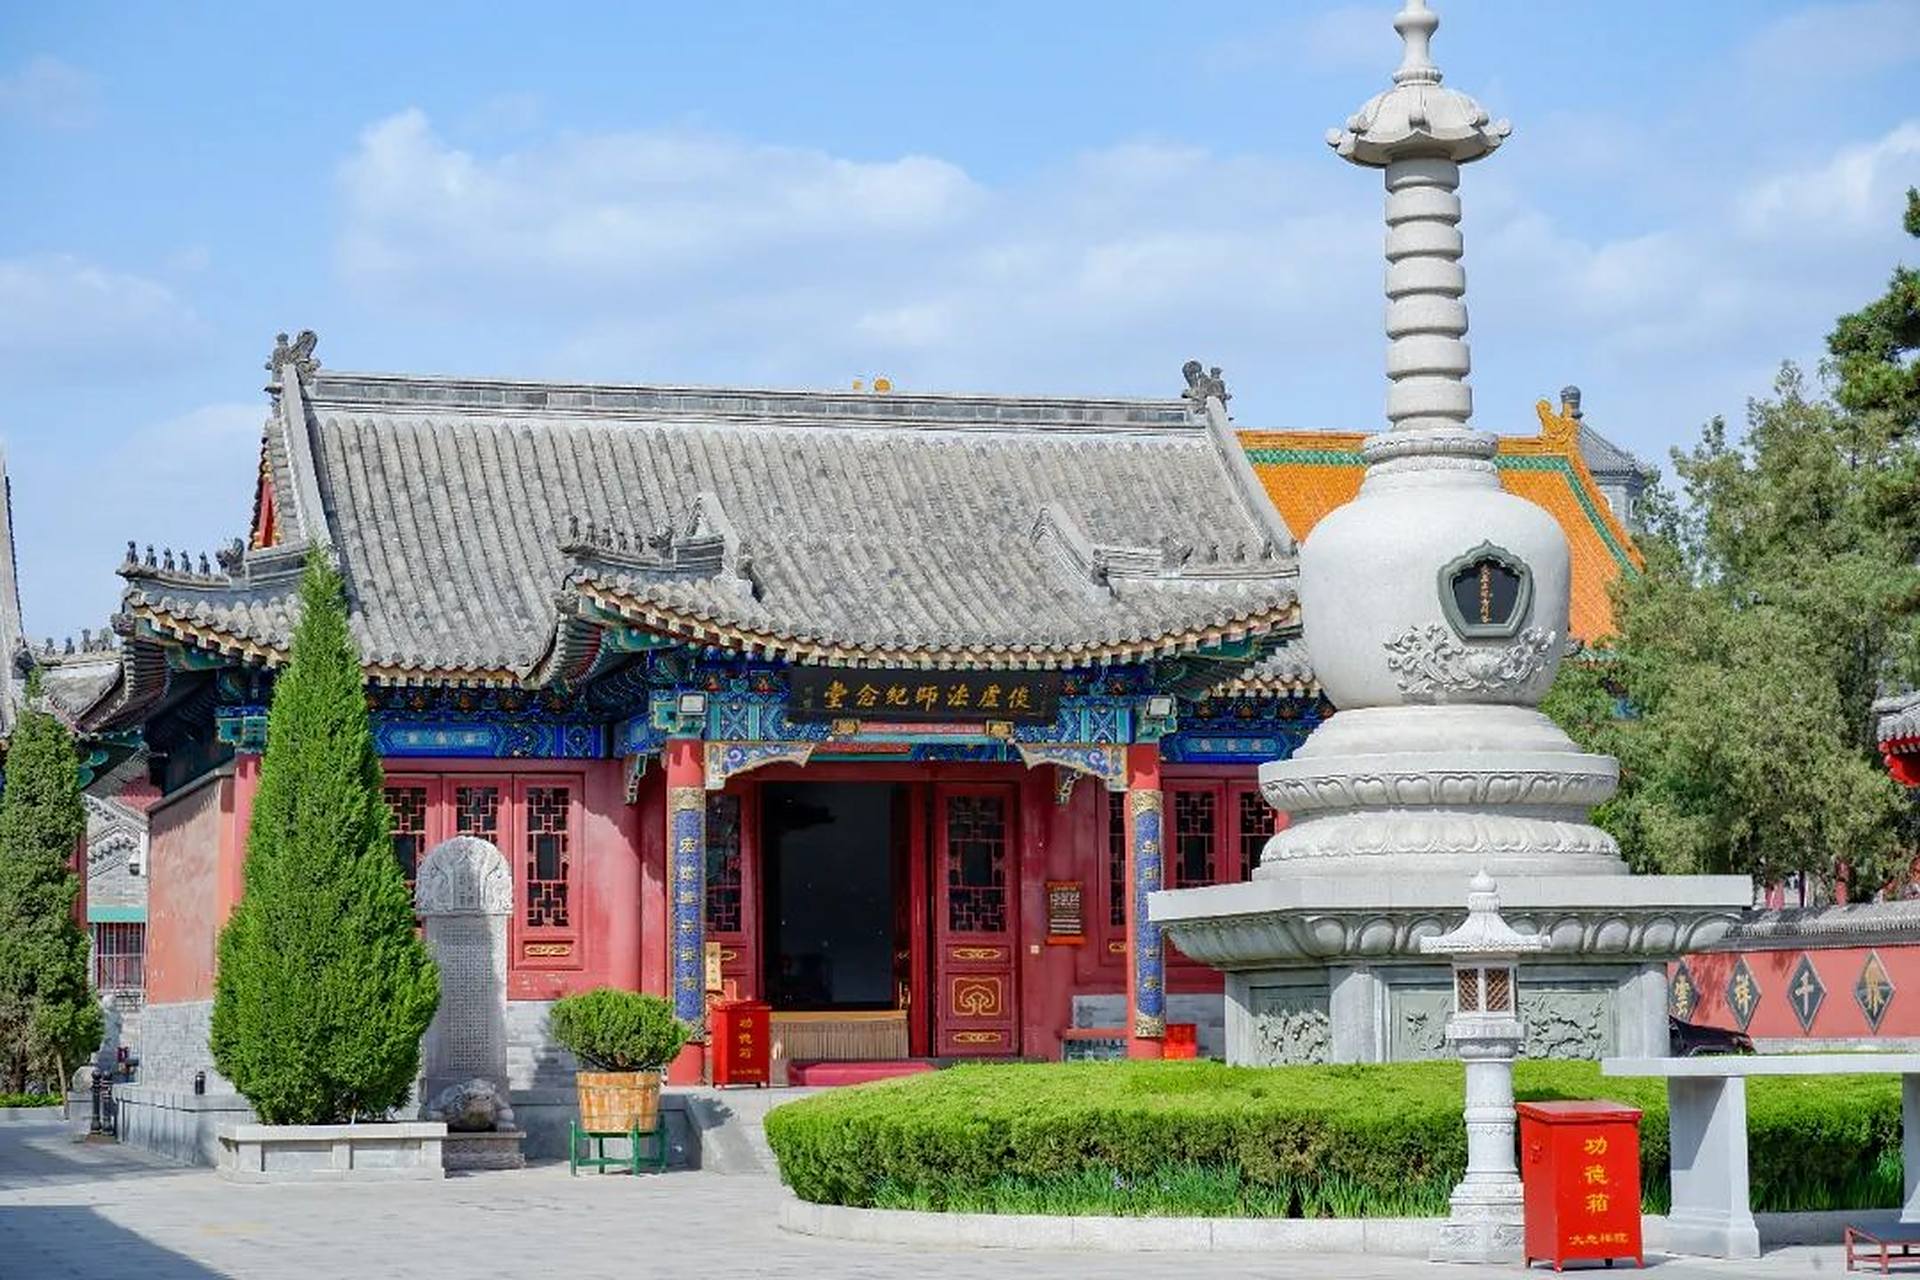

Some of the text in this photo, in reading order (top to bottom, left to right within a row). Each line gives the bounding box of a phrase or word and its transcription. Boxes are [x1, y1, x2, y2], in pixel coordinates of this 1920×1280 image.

[1795, 970, 1814, 1016] 千
[1584, 1136, 1609, 1213] 功德箱
